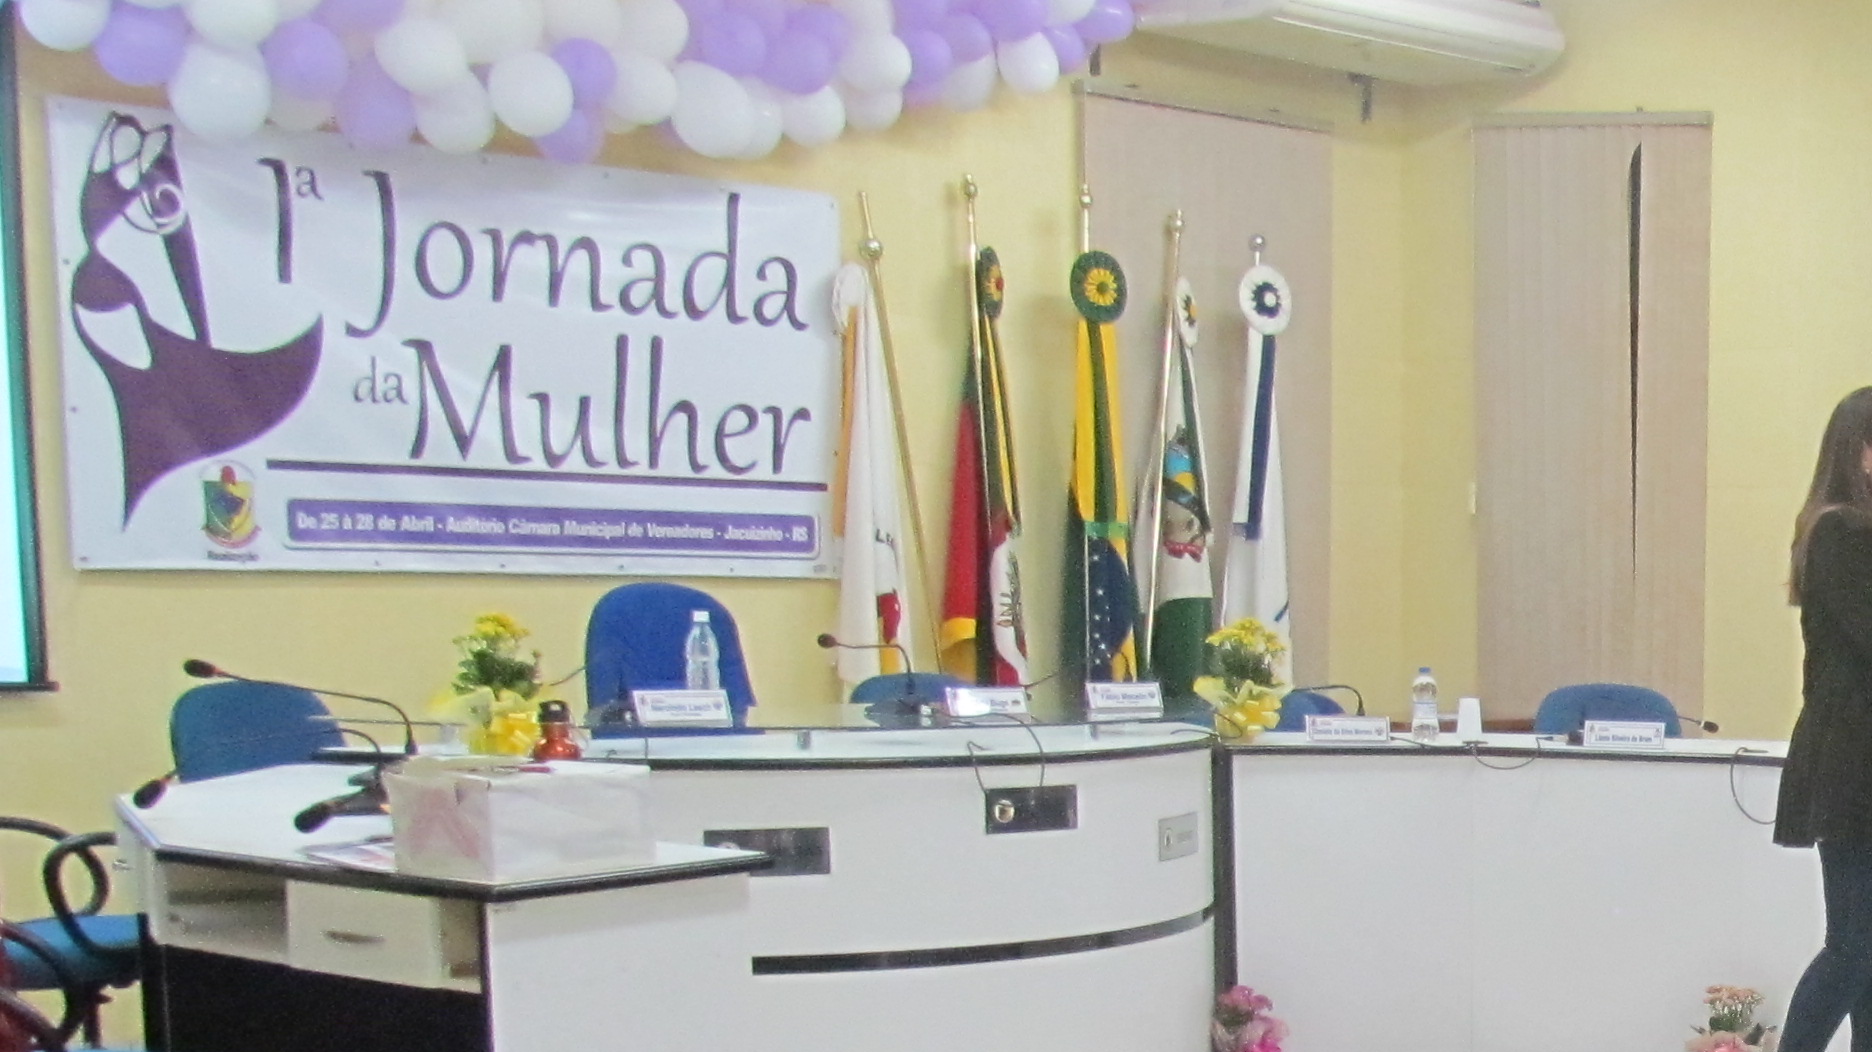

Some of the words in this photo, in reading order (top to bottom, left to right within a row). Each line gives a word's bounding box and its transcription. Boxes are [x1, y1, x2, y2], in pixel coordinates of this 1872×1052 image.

[344, 168, 811, 339] Jornada
[352, 356, 409, 407] da
[401, 333, 812, 476] Mulher
[296, 511, 317, 529] De
[320, 512, 340, 530] 25
[354, 512, 374, 531] 28
[377, 513, 396, 531] de
[400, 514, 434, 532] Abril
[563, 519, 625, 540] Municipal
[627, 521, 644, 538] de
[646, 521, 715, 540] Vereadores
[792, 525, 809, 543] RS
